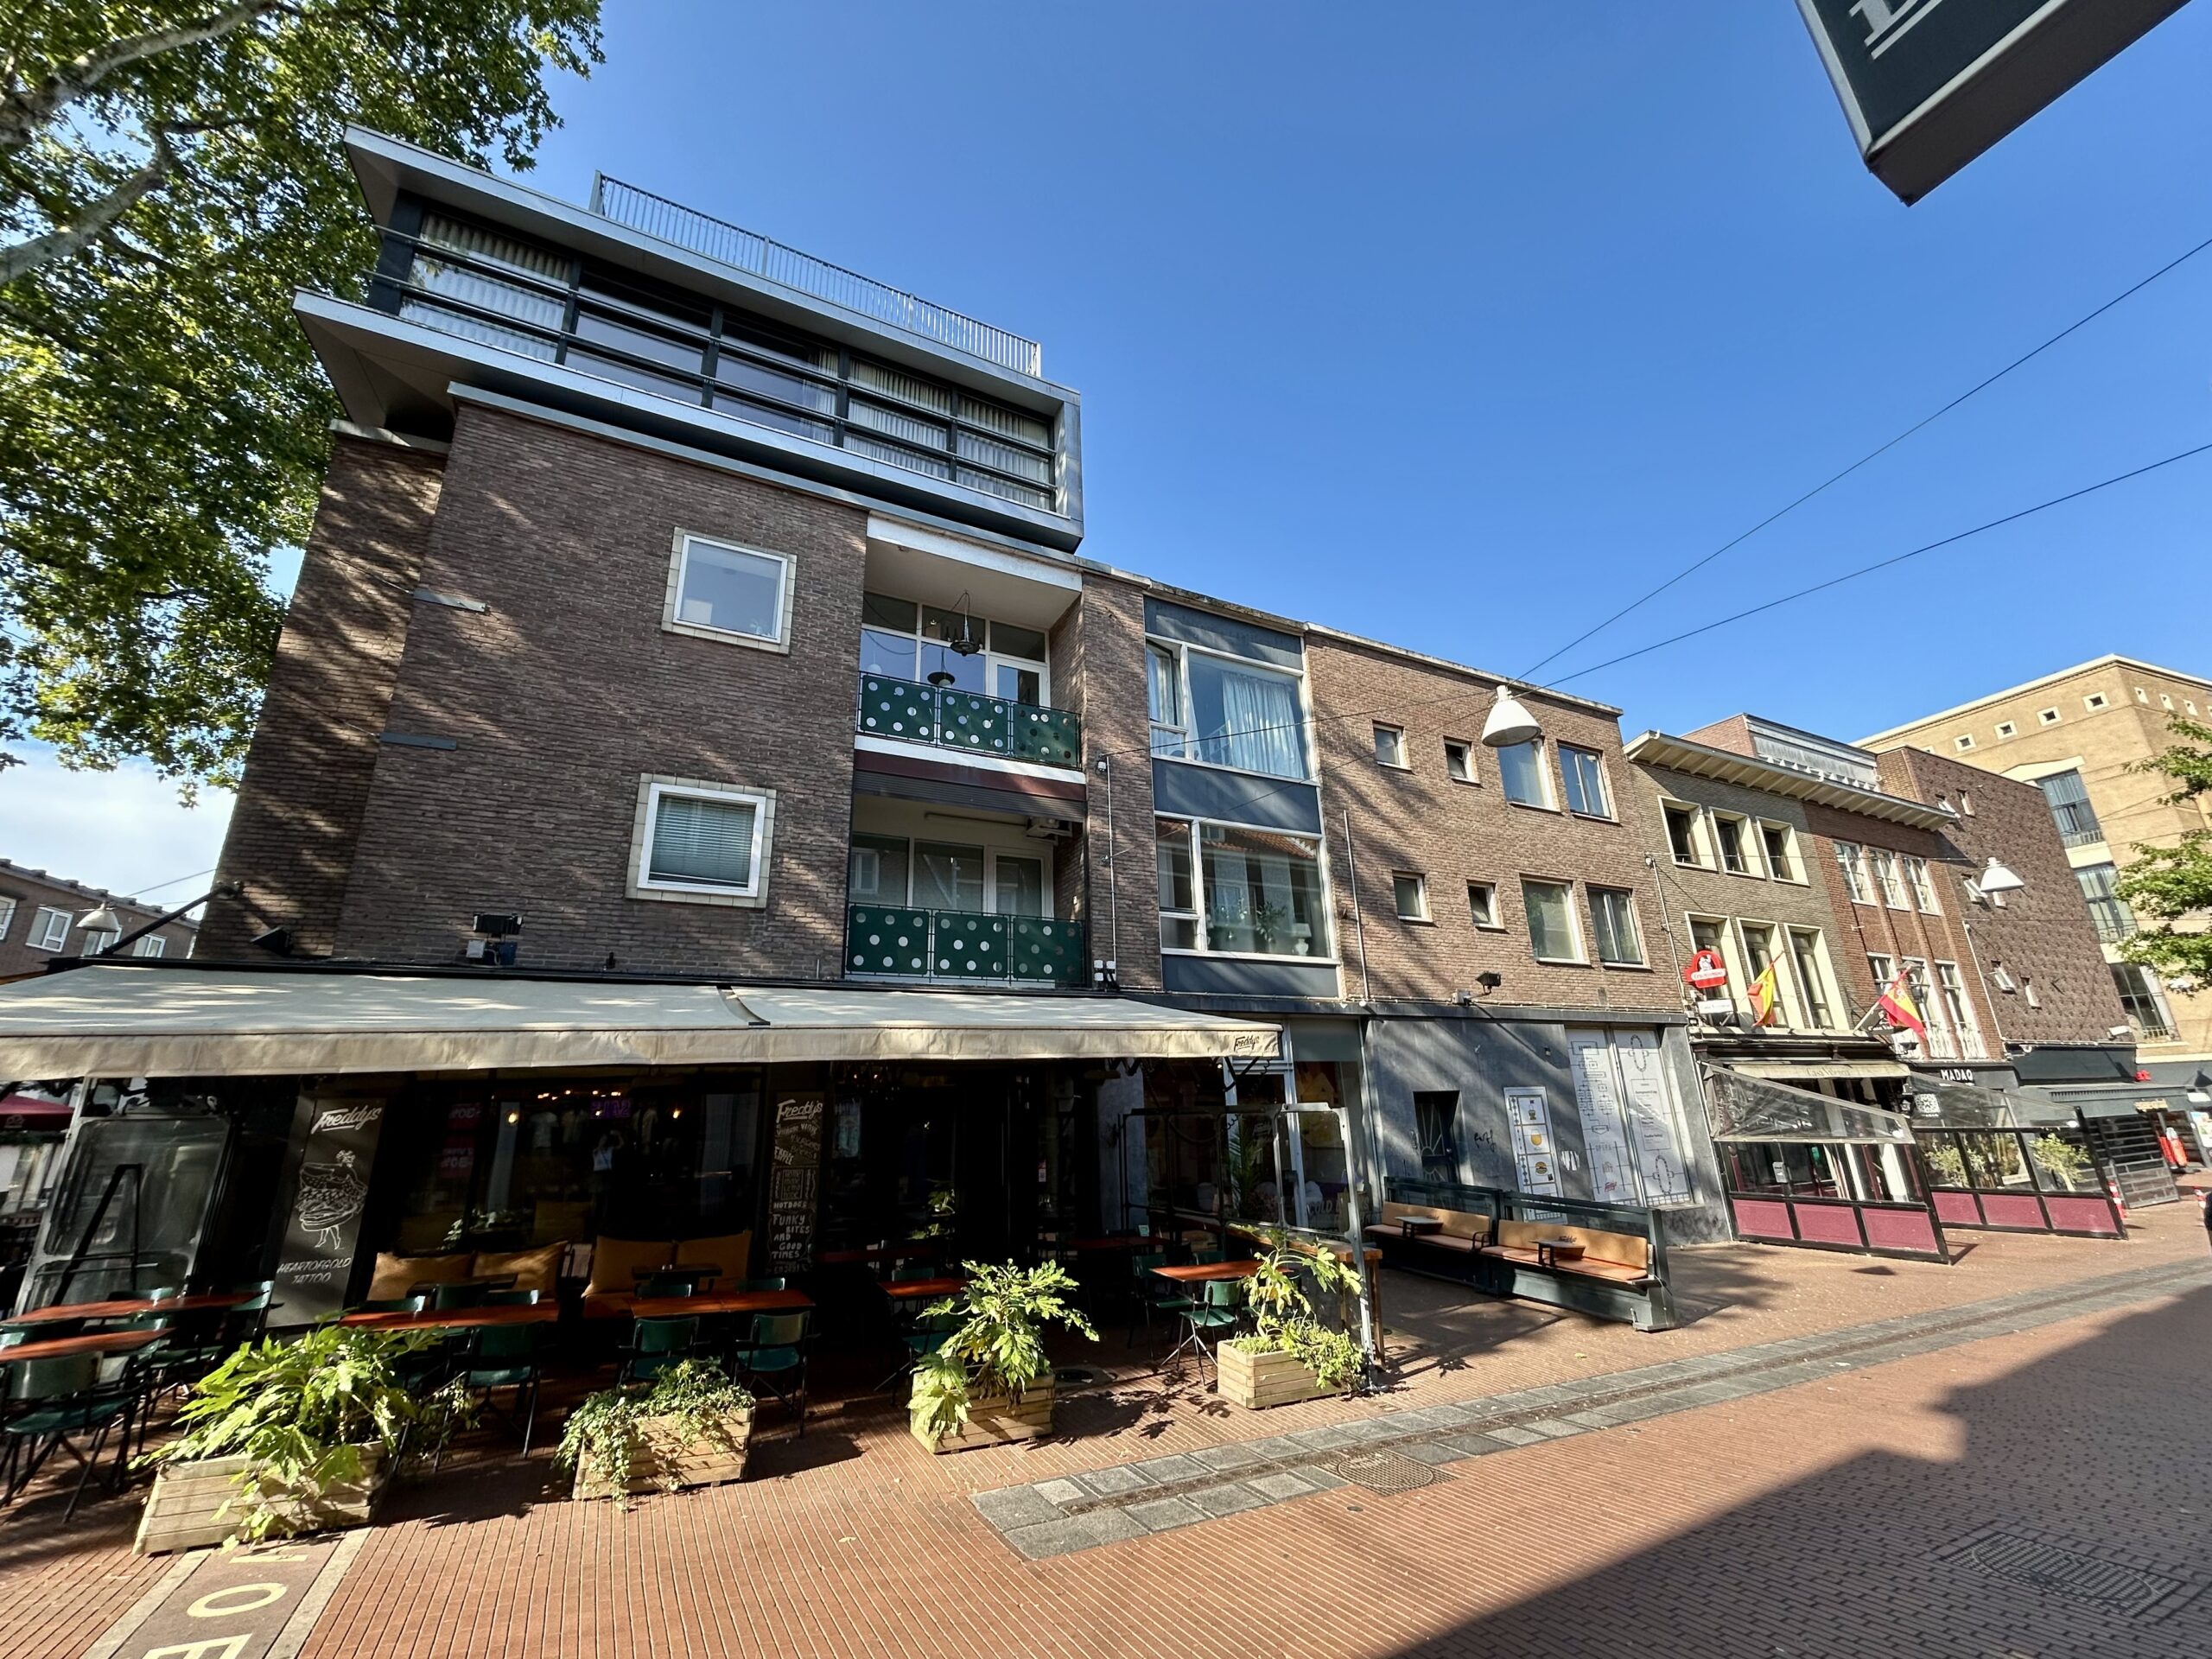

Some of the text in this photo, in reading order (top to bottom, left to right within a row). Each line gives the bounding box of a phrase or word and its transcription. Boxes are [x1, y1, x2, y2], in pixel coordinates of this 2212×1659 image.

[775, 1098, 823, 1124] Freddy's
[310, 1104, 383, 1135] Freddy's
[772, 1213, 805, 1226] FUNKY
[785, 1225, 810, 1234] BITES
[773, 1233, 791, 1242] AND
[779, 1242, 803, 1250] GOOD
[771, 1250, 800, 1260] TIMES
[291, 1271, 332, 1285] TATTOO
